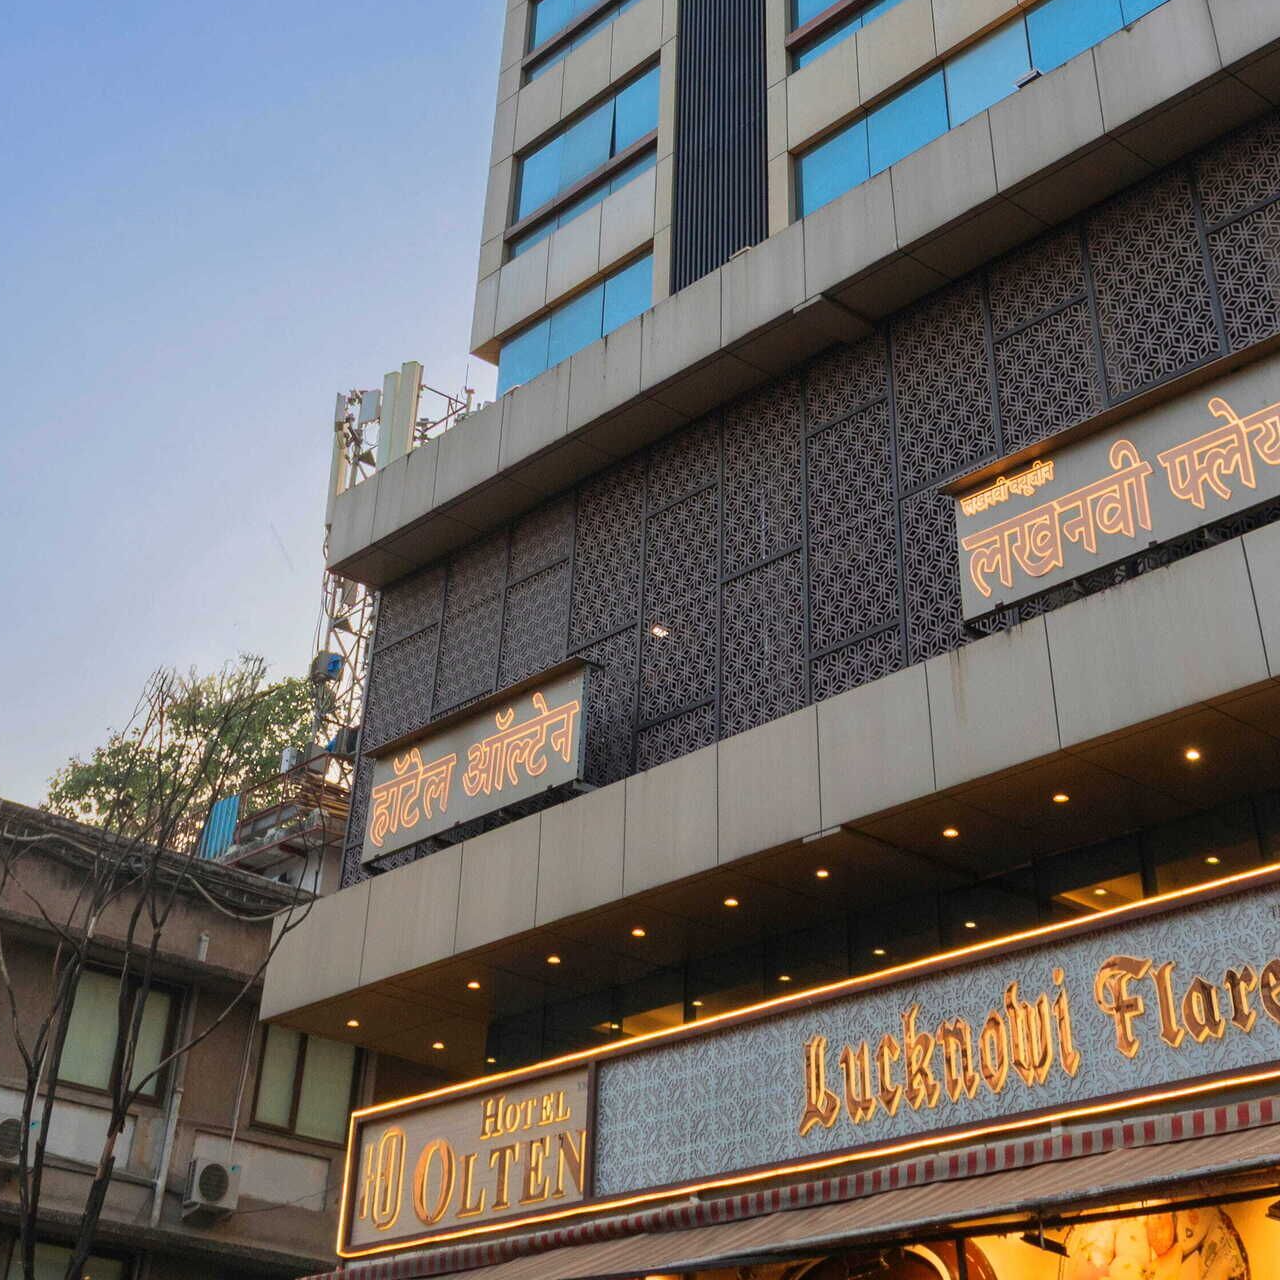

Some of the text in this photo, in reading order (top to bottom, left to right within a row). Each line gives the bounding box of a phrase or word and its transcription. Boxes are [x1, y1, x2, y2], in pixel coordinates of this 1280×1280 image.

[961, 439, 1153, 598] लखनवी
[370, 692, 580, 848] हॉटेल ऑल्टेन
[479, 1089, 571, 1140] HOTEL
[800, 967, 1081, 1136] Lucknowi
[412, 1128, 588, 1225] OLTEN
